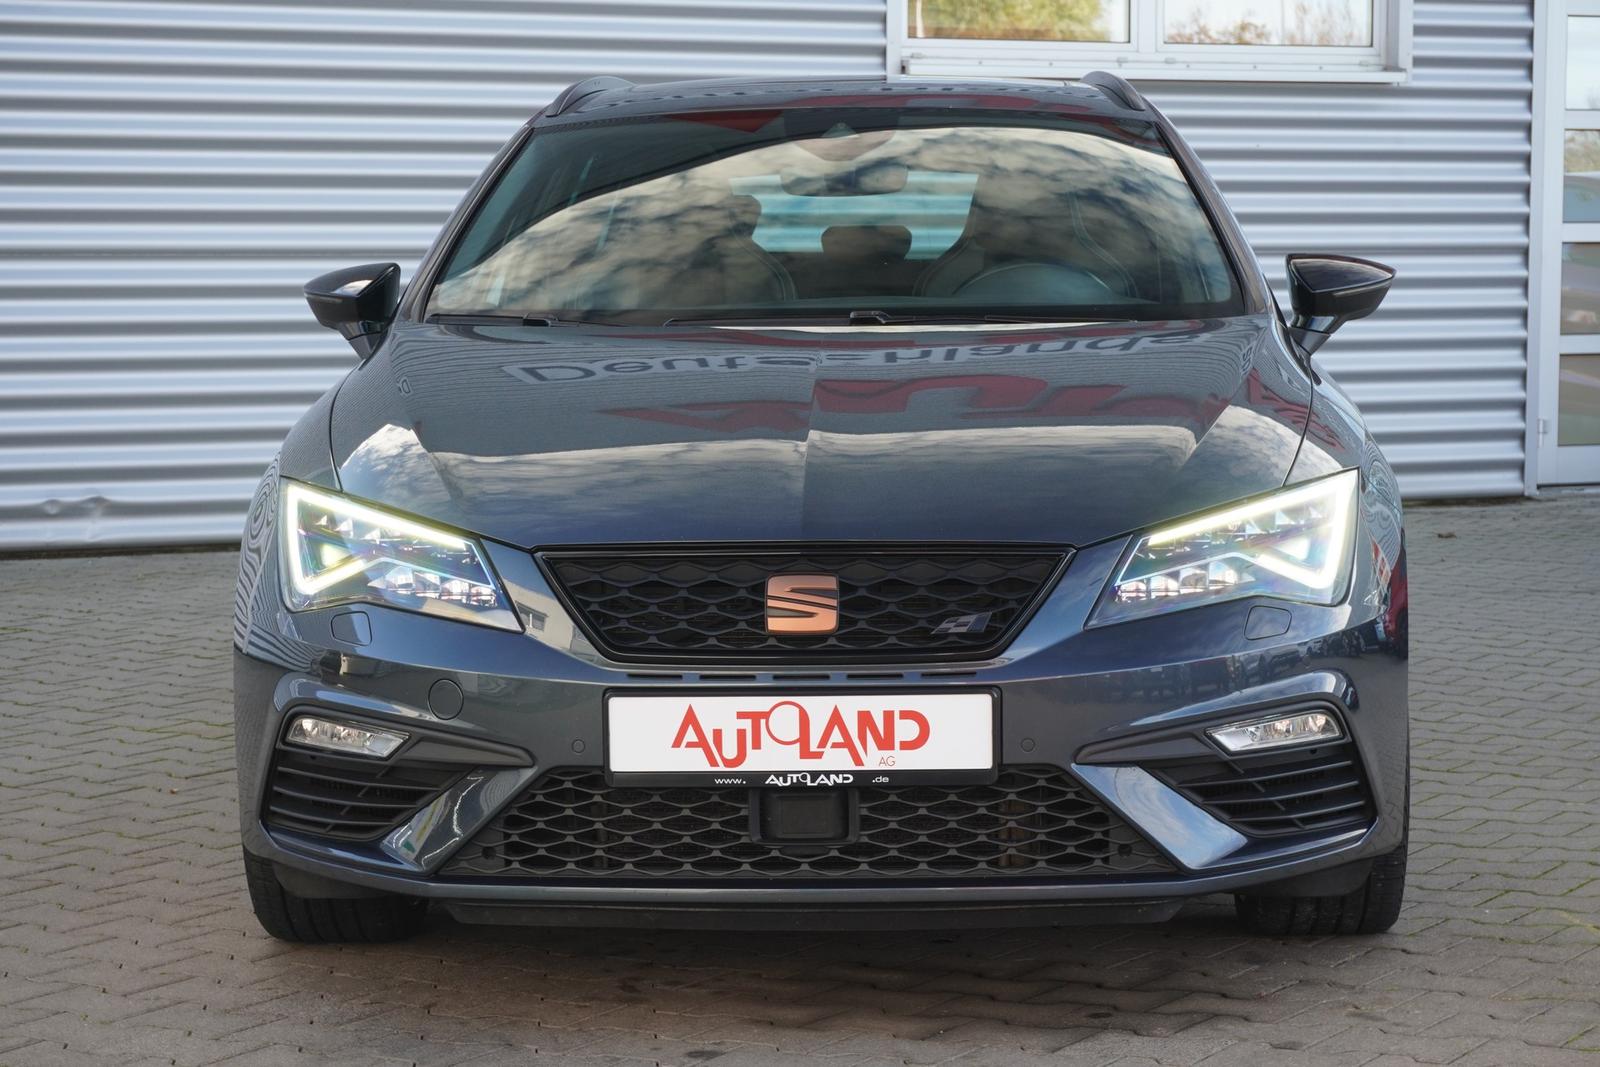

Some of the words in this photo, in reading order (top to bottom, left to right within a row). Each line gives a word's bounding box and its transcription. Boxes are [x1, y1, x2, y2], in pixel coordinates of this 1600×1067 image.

[878, 756, 896, 767] AG
[714, 777, 747, 785] www.
[872, 775, 890, 784] .de
